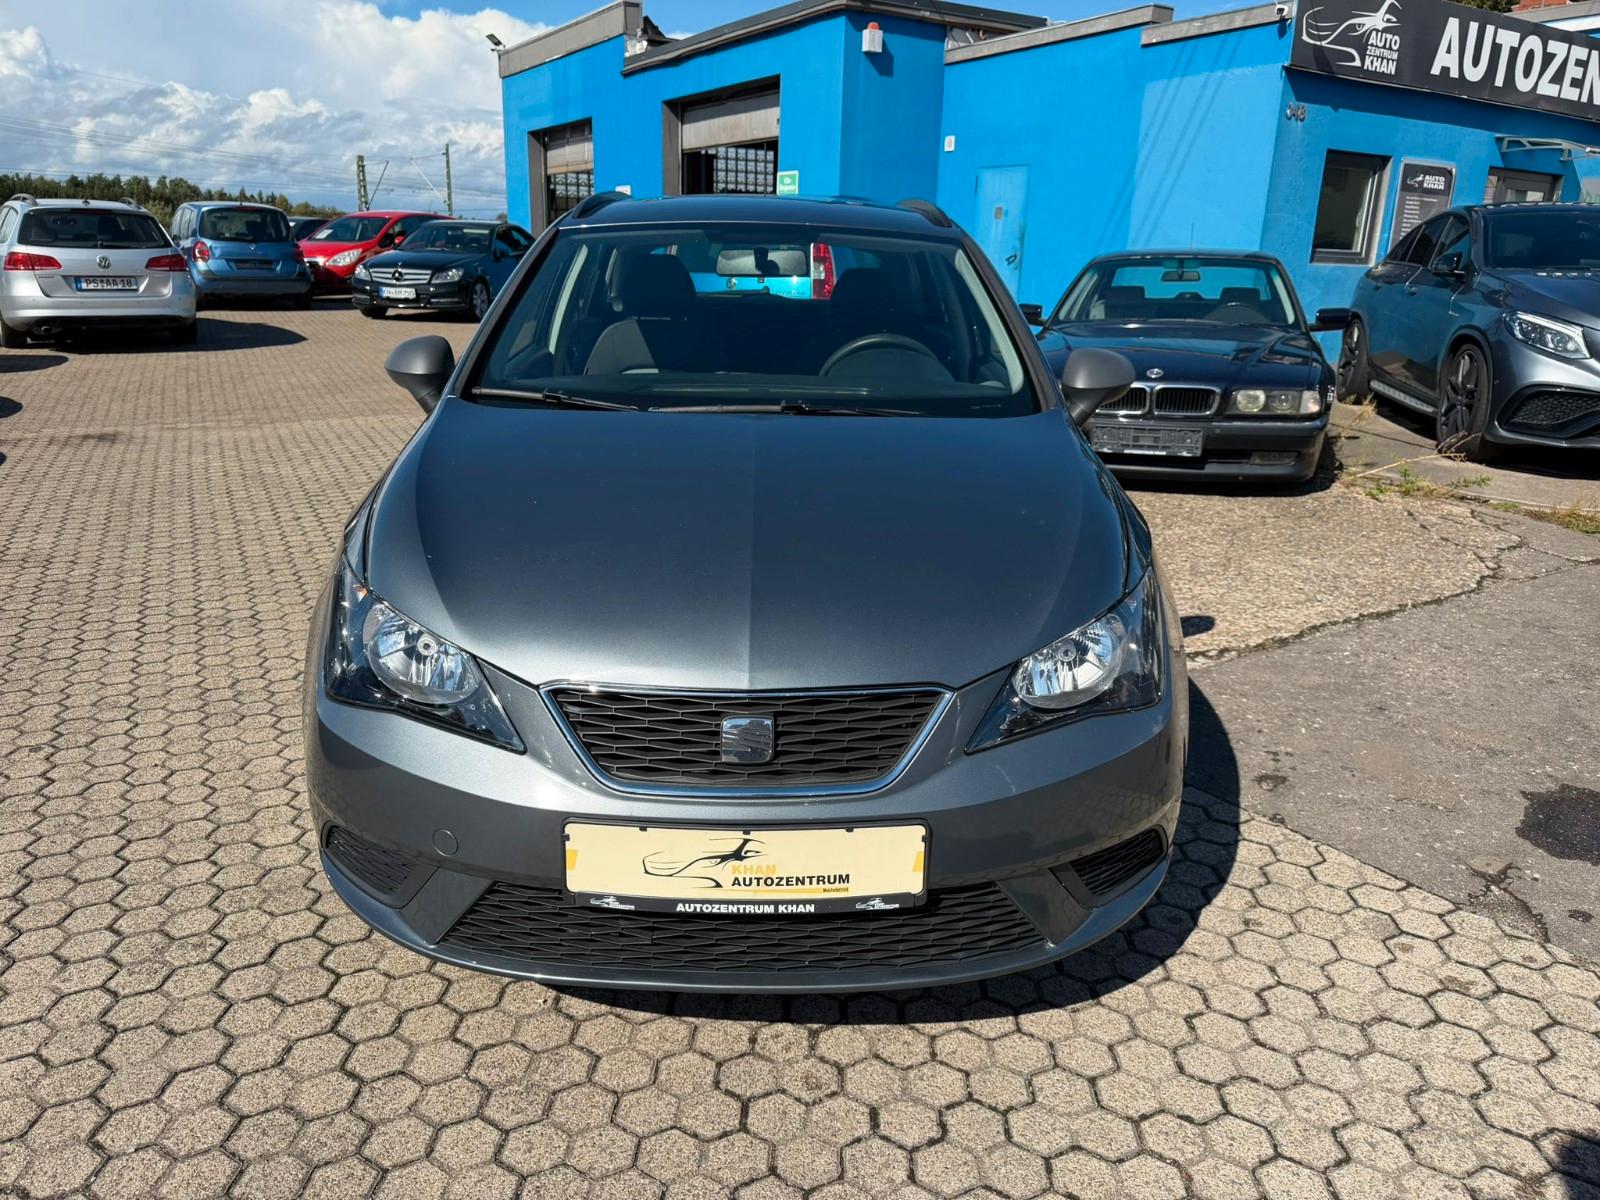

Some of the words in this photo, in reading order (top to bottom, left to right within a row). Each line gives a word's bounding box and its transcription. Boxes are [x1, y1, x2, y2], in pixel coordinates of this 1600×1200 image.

[1368, 31, 1400, 50] AUTO
[1366, 46, 1398, 60] ZENTRUM
[1364, 56, 1397, 75] KHAN
[732, 865, 776, 875] KHAN
[731, 874, 850, 887] AUTOZENTRUM
[676, 903, 775, 913] AUTOZENTRUM
[778, 904, 815, 913] KHAN
